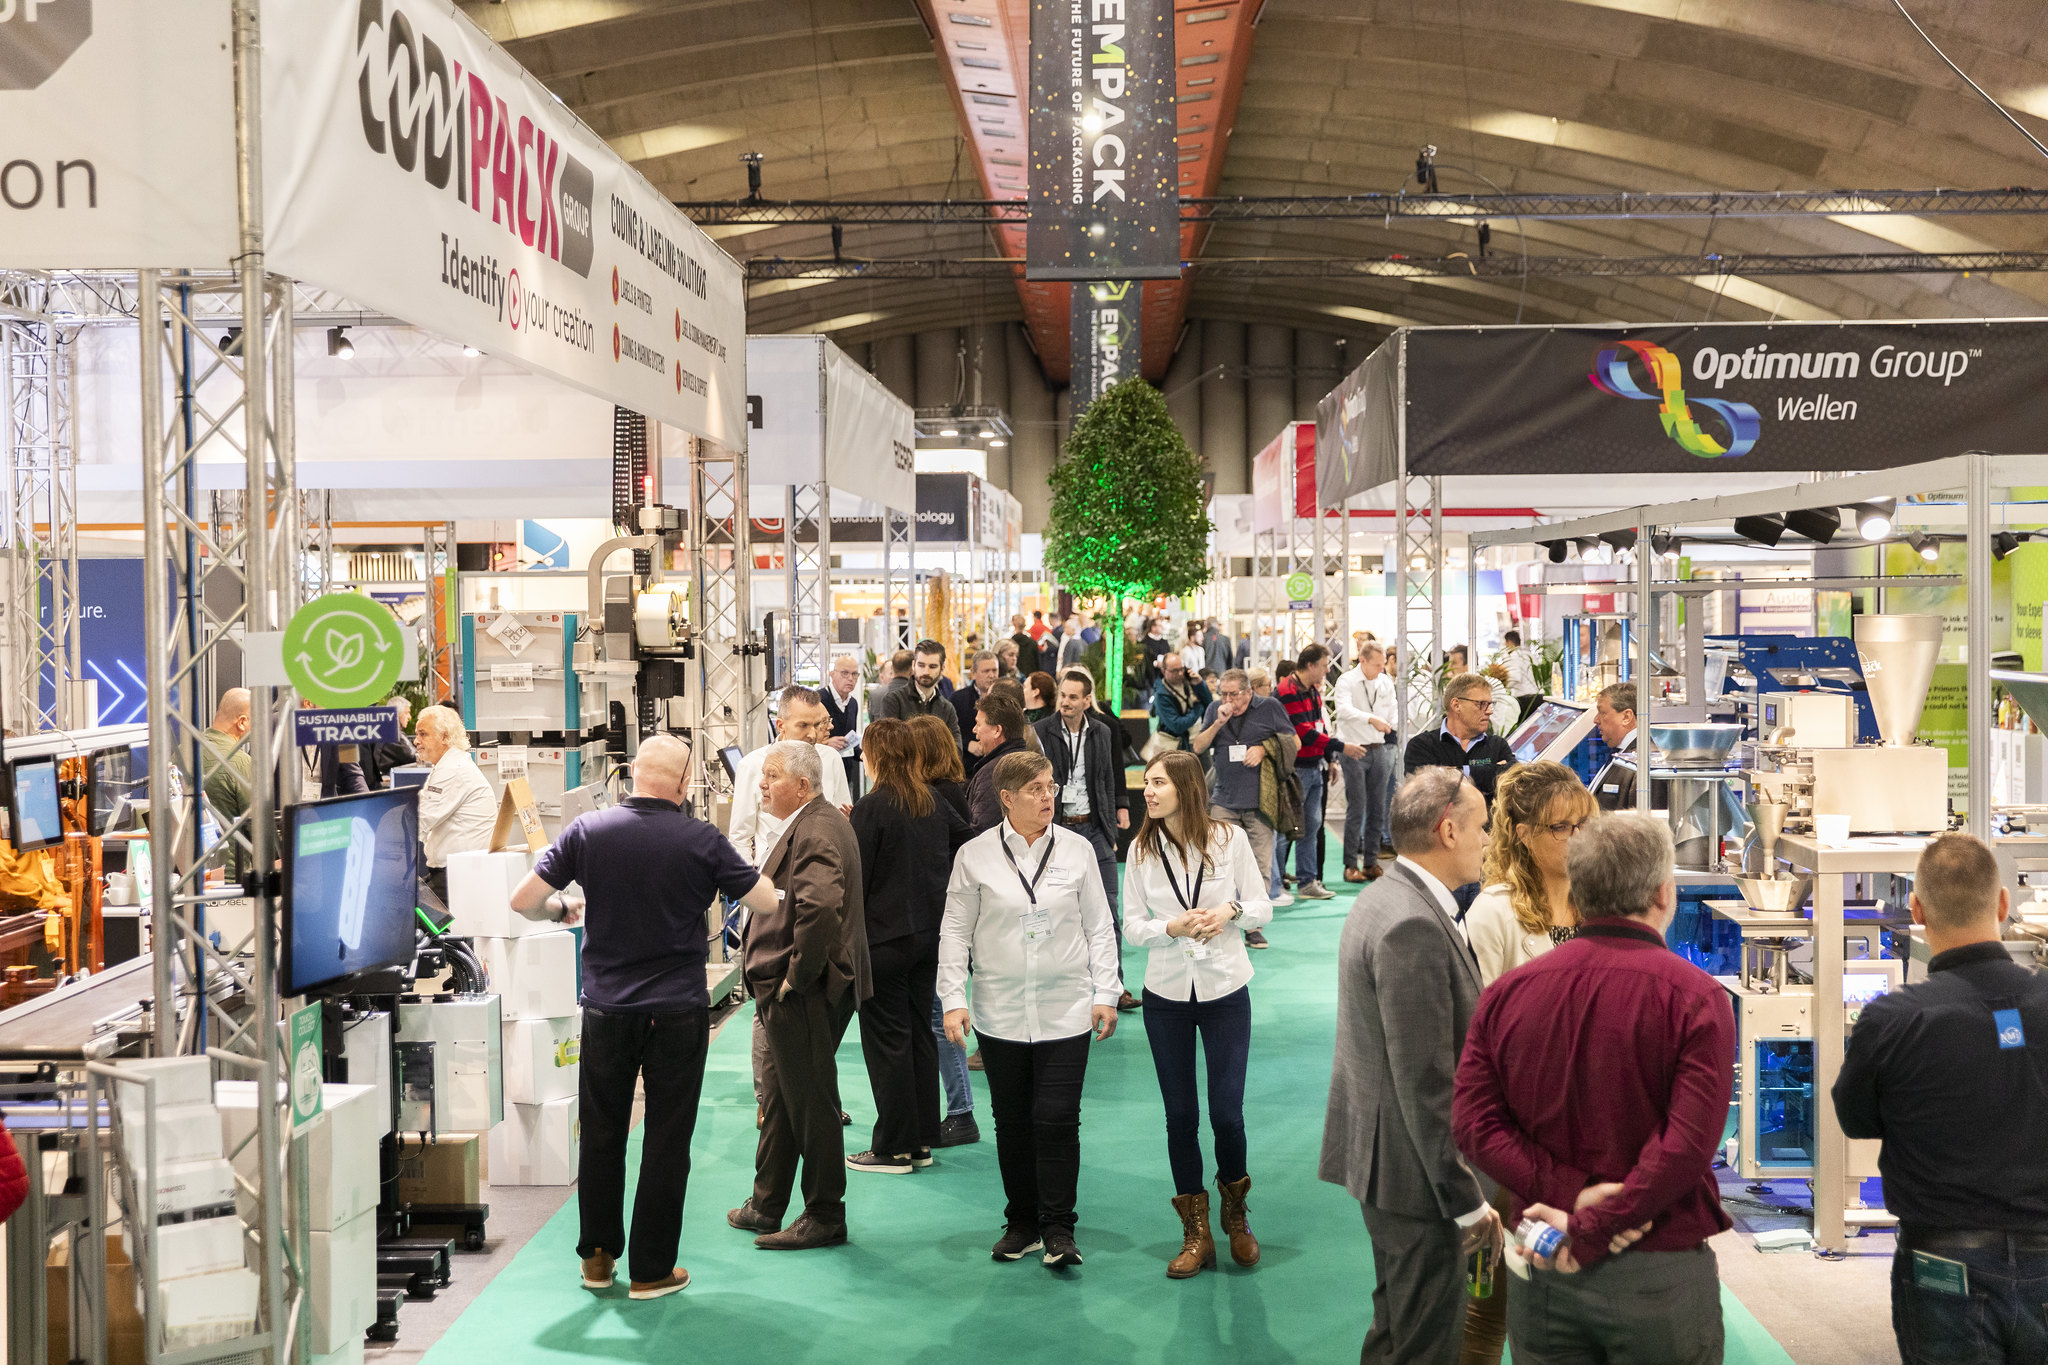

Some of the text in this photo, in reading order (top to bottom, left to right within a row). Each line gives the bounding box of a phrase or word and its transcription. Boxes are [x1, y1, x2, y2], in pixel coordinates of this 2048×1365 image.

[1072, 28, 1082, 87] FUTURE
[1072, 91, 1082, 112] OF
[1092, 0, 1126, 203] EMPACK
[1071, 116, 1083, 205] PACKAGING
[563, 193, 589, 238] GROUP
[611, 192, 637, 250] CODING
[640, 216, 645, 256] &
[646, 221, 676, 279] LABELING
[441, 232, 595, 354] Identify your creation
[1101, 308, 1119, 393] EMPAC
[1692, 343, 1860, 389] Optimum
[1777, 394, 1858, 421] Wellen
[298, 712, 395, 725] SUSTAINABILITY
[312, 724, 382, 742] TRACK
